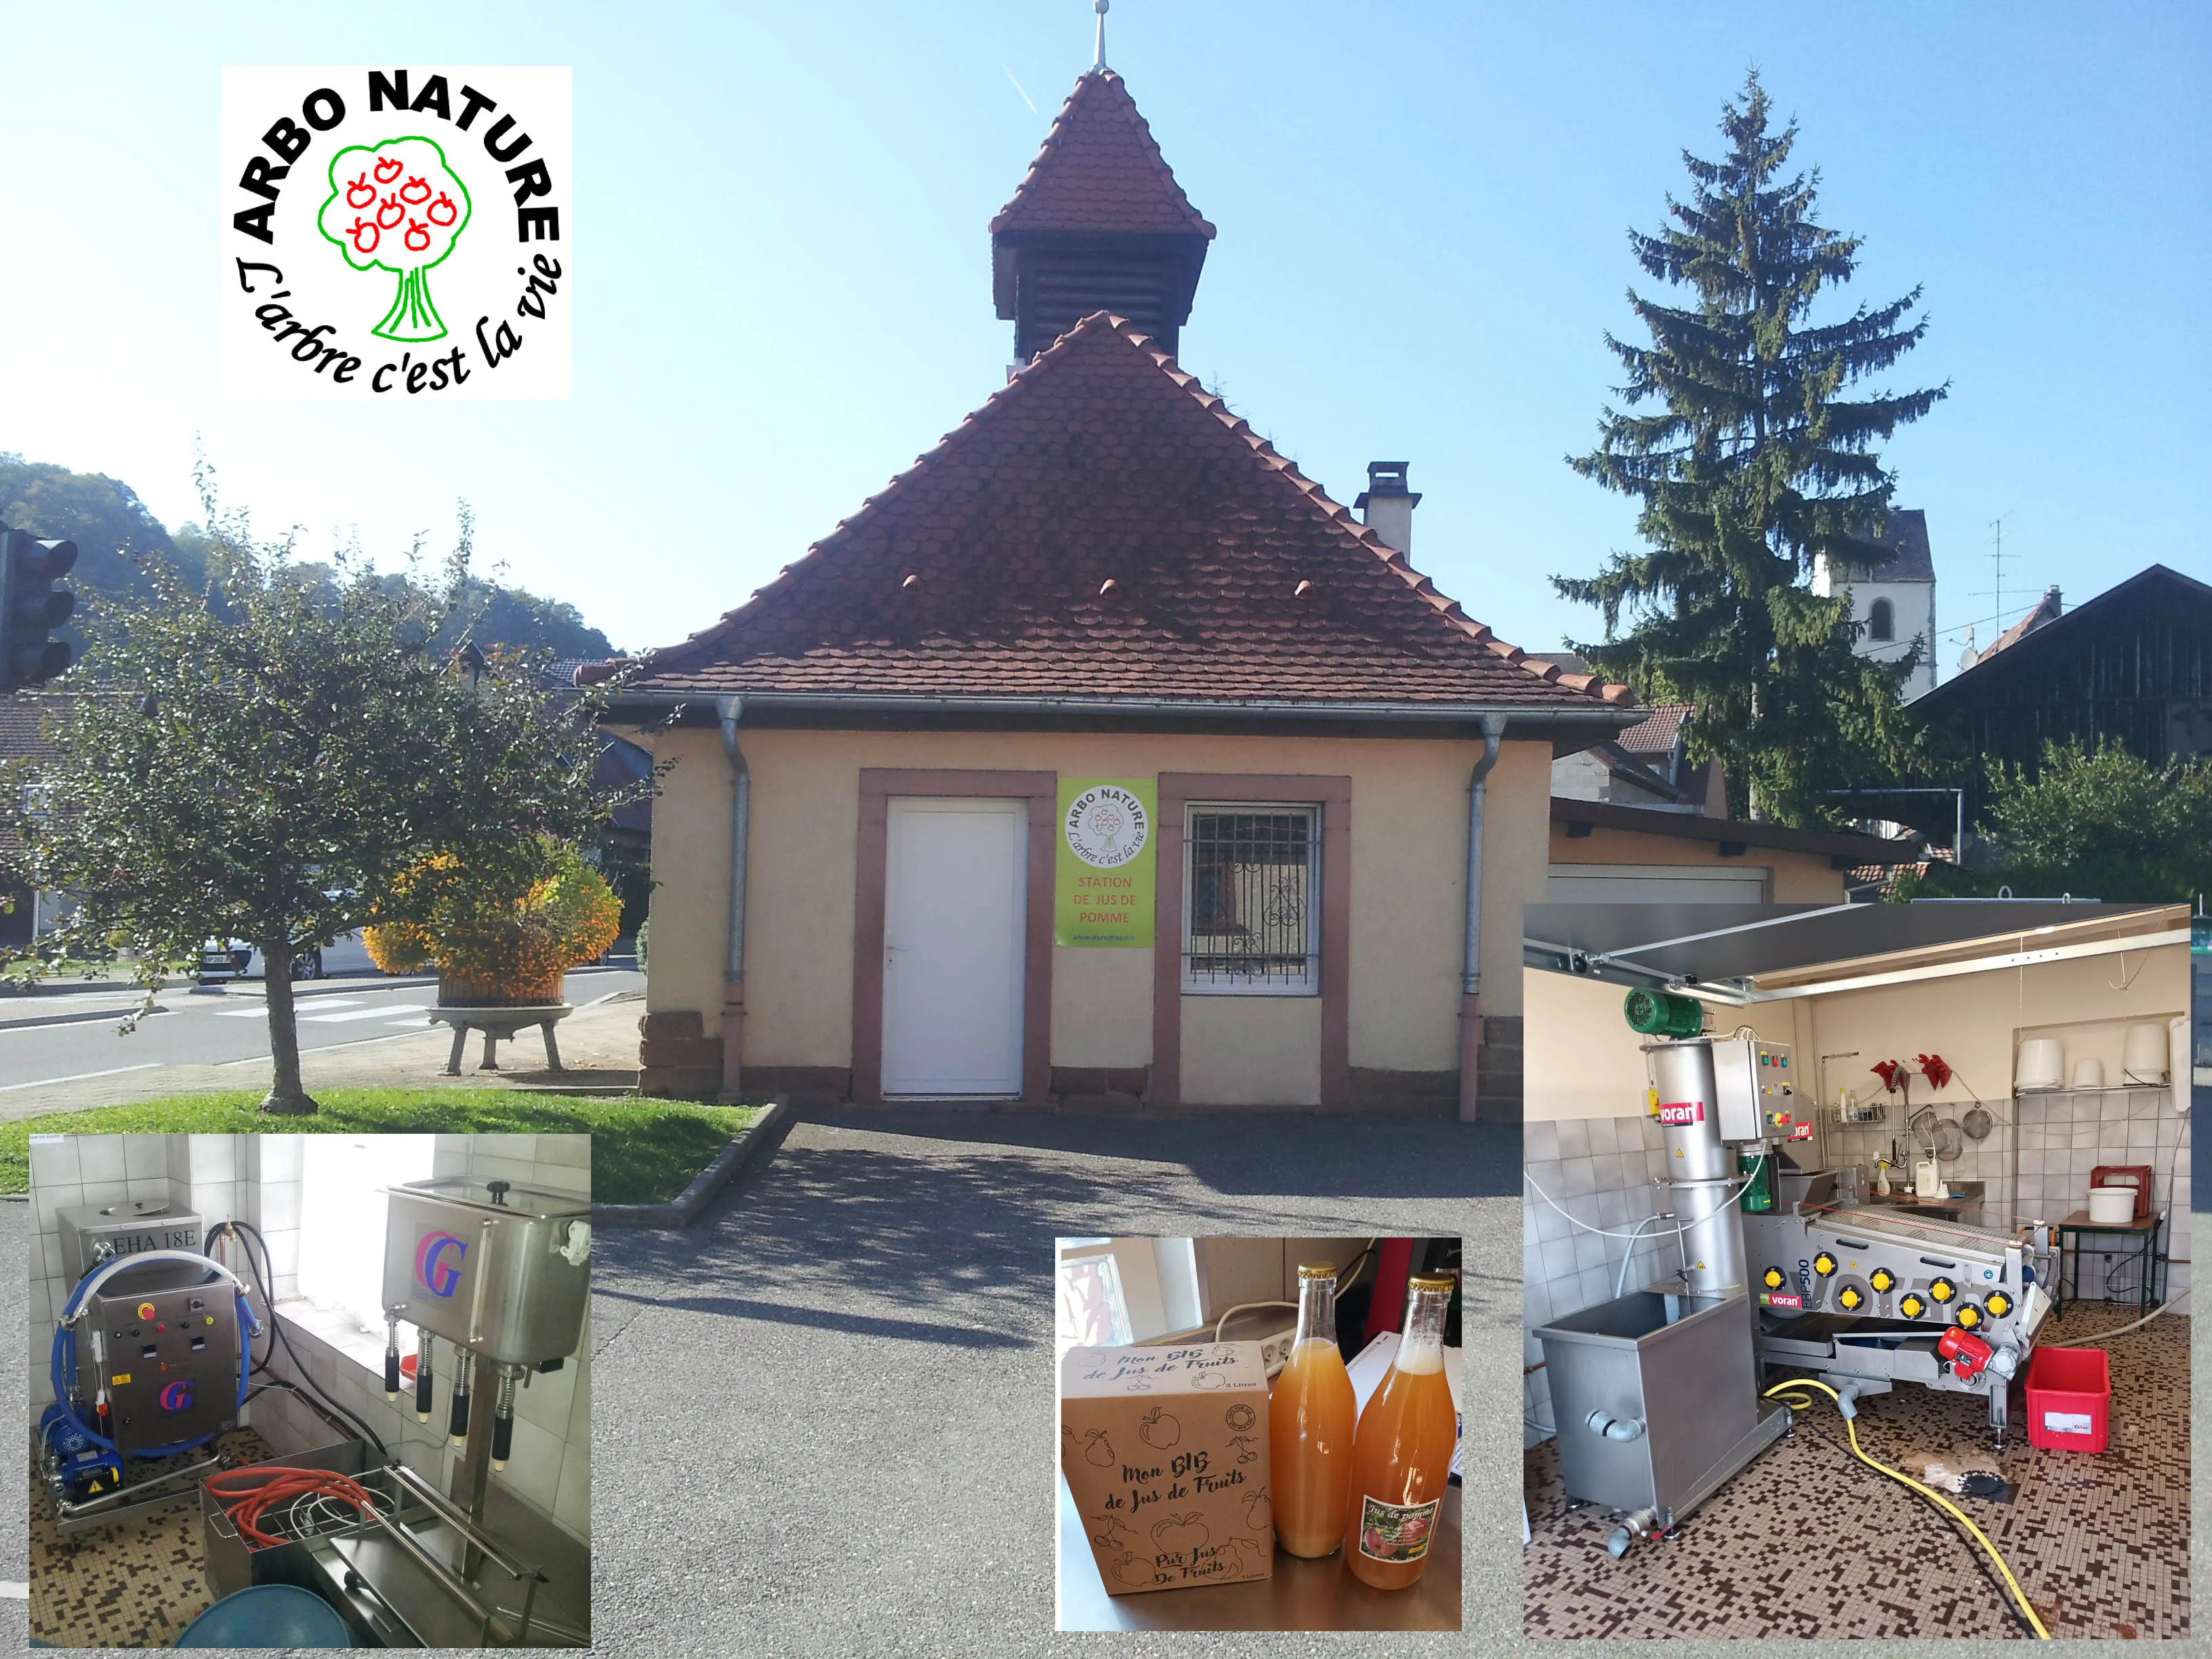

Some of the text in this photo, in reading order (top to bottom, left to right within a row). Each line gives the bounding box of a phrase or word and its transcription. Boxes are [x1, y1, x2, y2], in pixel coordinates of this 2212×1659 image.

[1069, 789, 1145, 830] ARBO NATURE
[1099, 853, 1122, 864] c'est
[1123, 844, 1134, 858] la
[1132, 831, 1144, 847] vie
[1079, 877, 1132, 887] STATION
[1073, 895, 1136, 905] DE JUS DE
[1080, 912, 1130, 923] POMME
[165, 1230, 196, 1248] 18E
[1798, 1259, 1813, 1309] EBP500
[1771, 1296, 1798, 1306] voran
[1118, 1349, 1205, 1365] Mon BIB
[1083, 1368, 1108, 1380] de
[1108, 1366, 1149, 1381] Jus
[1154, 1363, 1179, 1373] de
[1122, 1451, 1211, 1485] Mon BIB
[1105, 1469, 1246, 1513] de Jus de Fruits
[1368, 1504, 1386, 1517] Jus
[1387, 1509, 1399, 1519] de
[1155, 1547, 1218, 1568] Pur Jus
[1153, 1561, 1225, 1584] De Fruits
